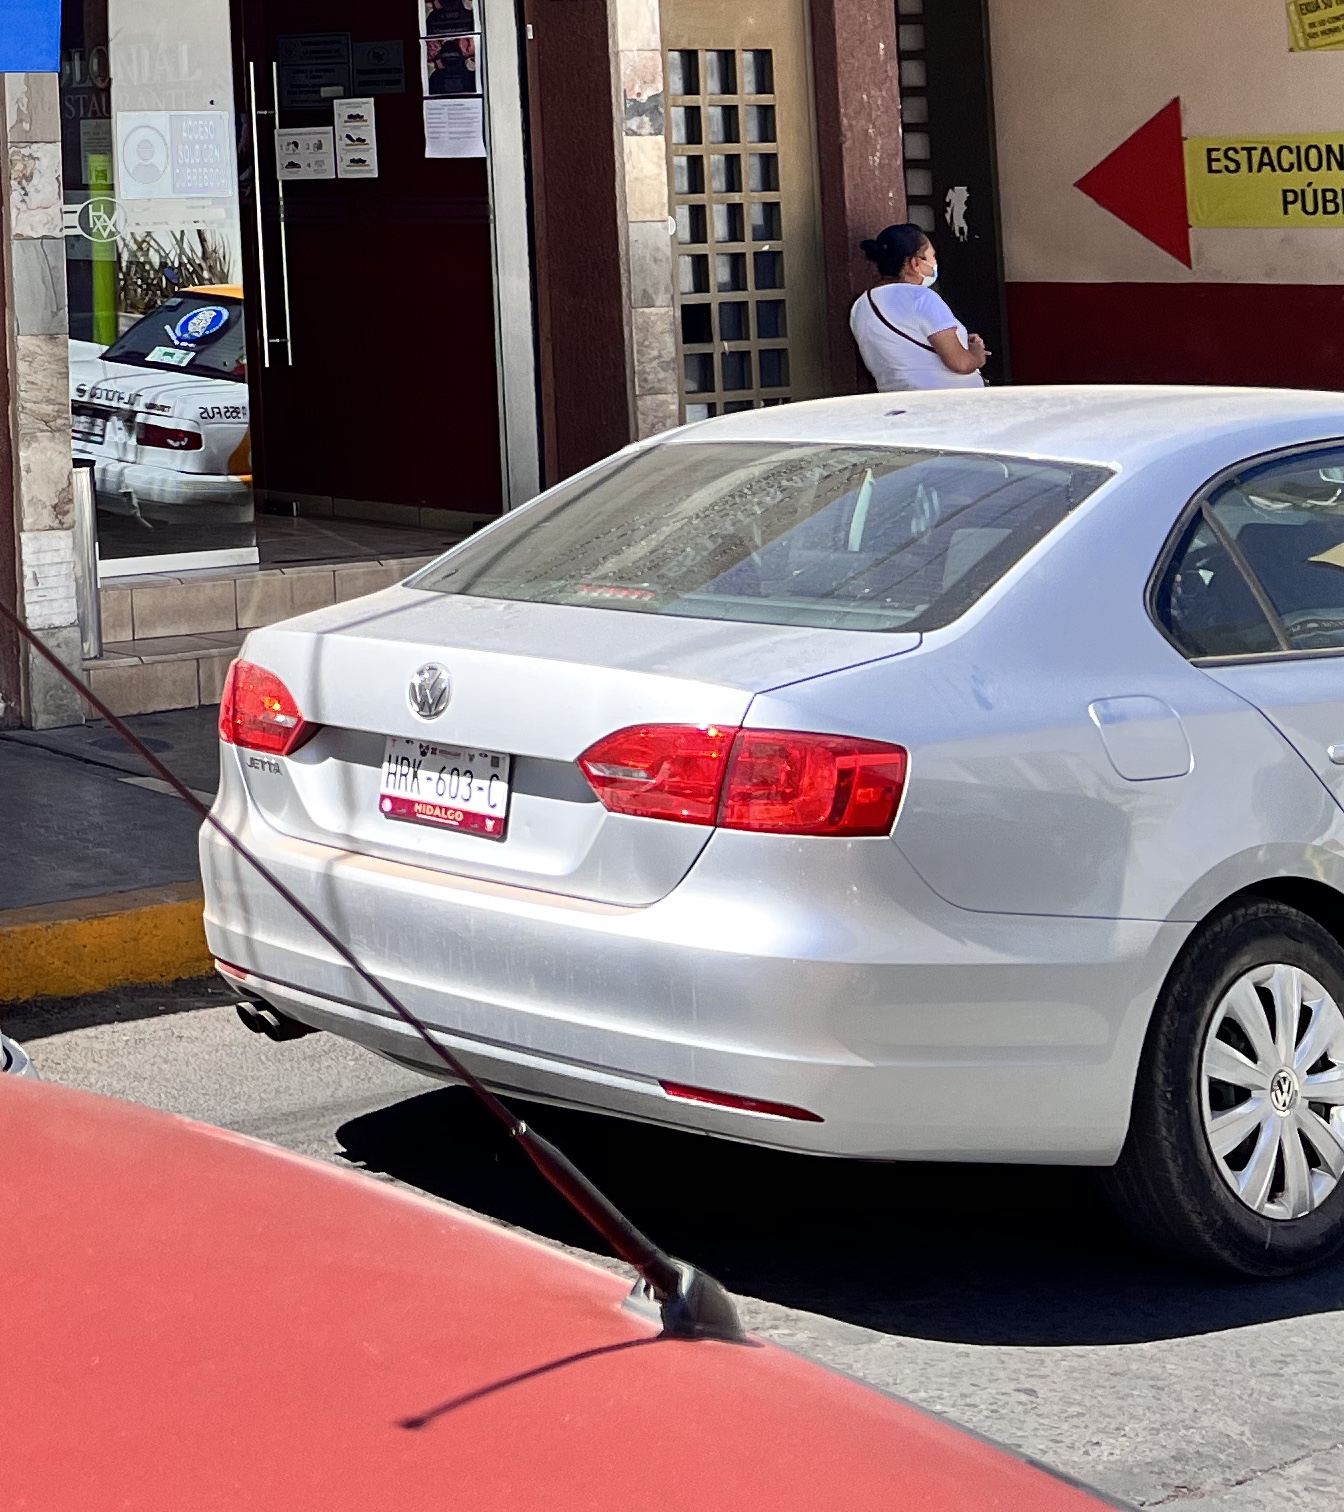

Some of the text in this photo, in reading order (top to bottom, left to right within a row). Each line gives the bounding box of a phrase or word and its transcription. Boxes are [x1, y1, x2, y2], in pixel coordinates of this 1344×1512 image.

[182, 119, 215, 141] ACCESO
[177, 143, 200, 165] SOLO
[1206, 144, 1344, 174] ESTACION
[1282, 182, 1344, 216] PÚB
[246, 756, 284, 777] JETTA
[385, 753, 501, 809] HRK-603-C
[414, 802, 464, 822] HIDALGO
